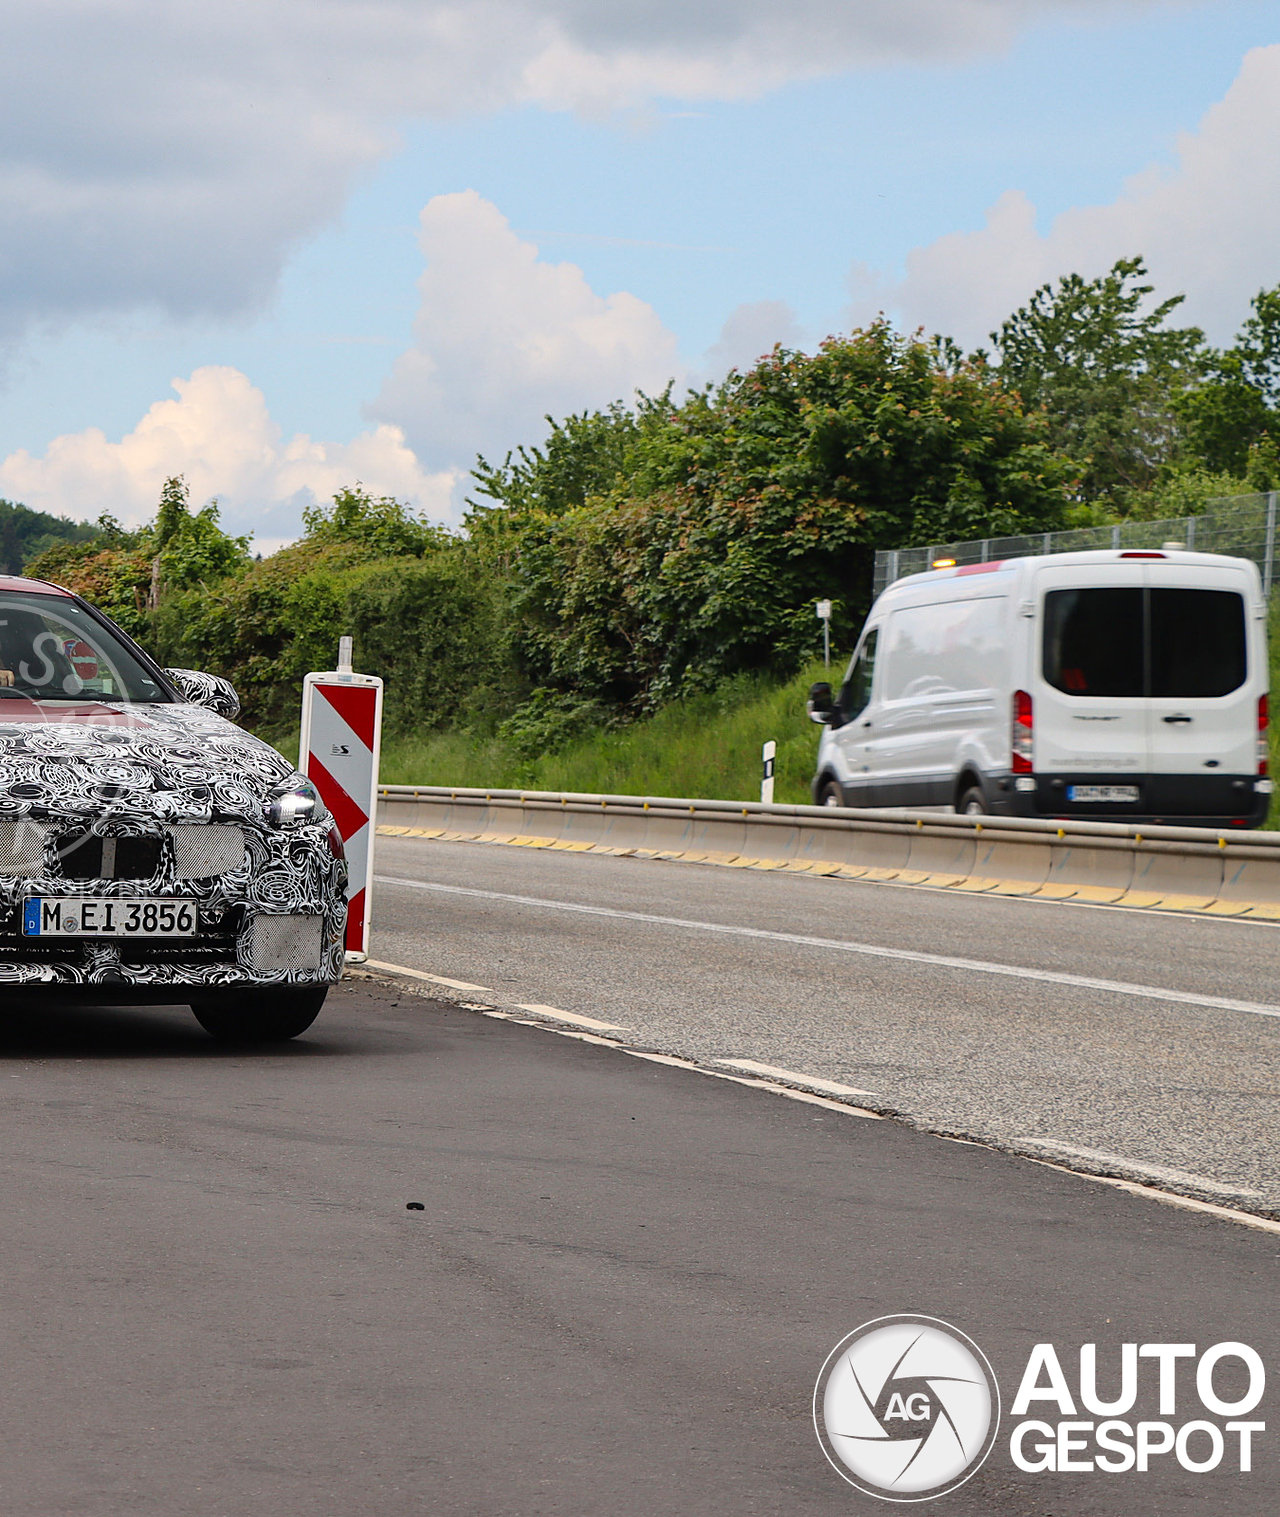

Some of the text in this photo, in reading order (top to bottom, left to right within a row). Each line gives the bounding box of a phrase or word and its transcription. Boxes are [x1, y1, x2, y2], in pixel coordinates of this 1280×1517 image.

[43, 902, 61, 931] M
[81, 903, 116, 931] EI
[124, 903, 193, 932] 3856
